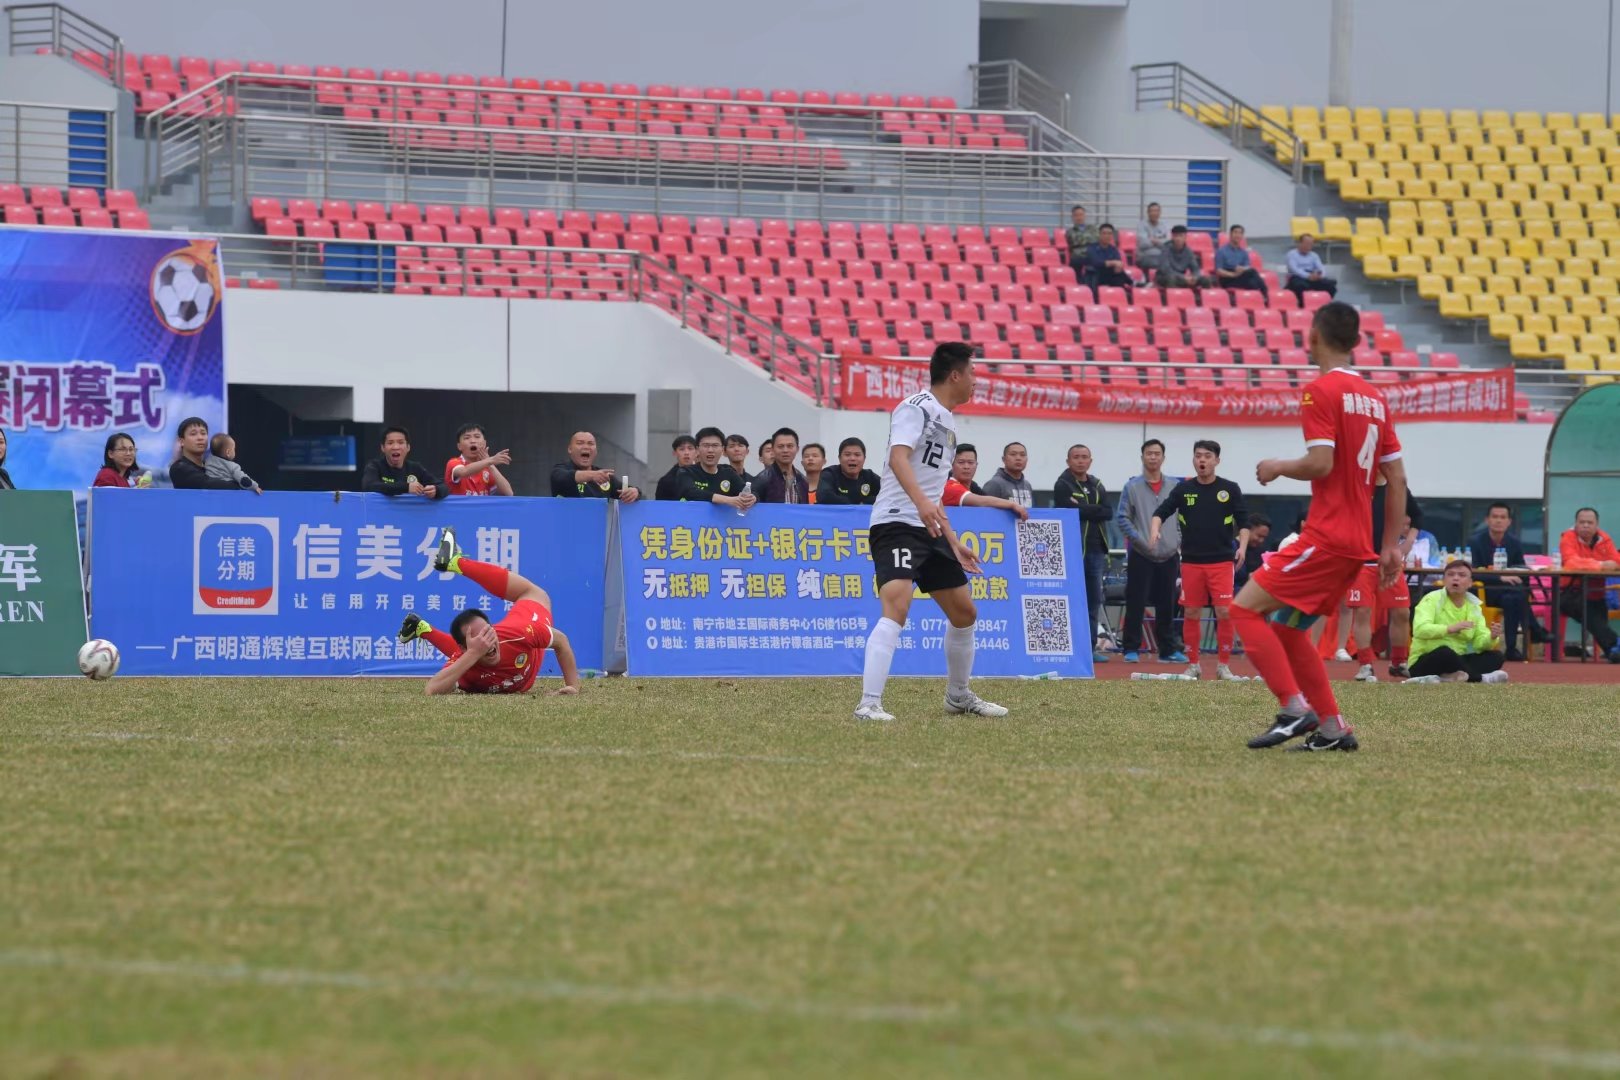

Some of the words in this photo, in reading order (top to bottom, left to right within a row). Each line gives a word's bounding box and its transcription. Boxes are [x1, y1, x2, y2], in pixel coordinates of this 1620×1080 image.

[0, 362, 164, 431] 闭幕式
[921, 440, 944, 469] 12
[1357, 423, 1379, 485] 4
[217, 536, 256, 558] 信美
[891, 547, 912, 569] 12
[217, 560, 256, 582] 分期
[643, 567, 710, 599] 无抵押
[720, 567, 787, 599] 无担保
[796, 568, 863, 600] 纯信用
[216, 596, 255, 606] CreditMate
[1349, 589, 1360, 602] 13
